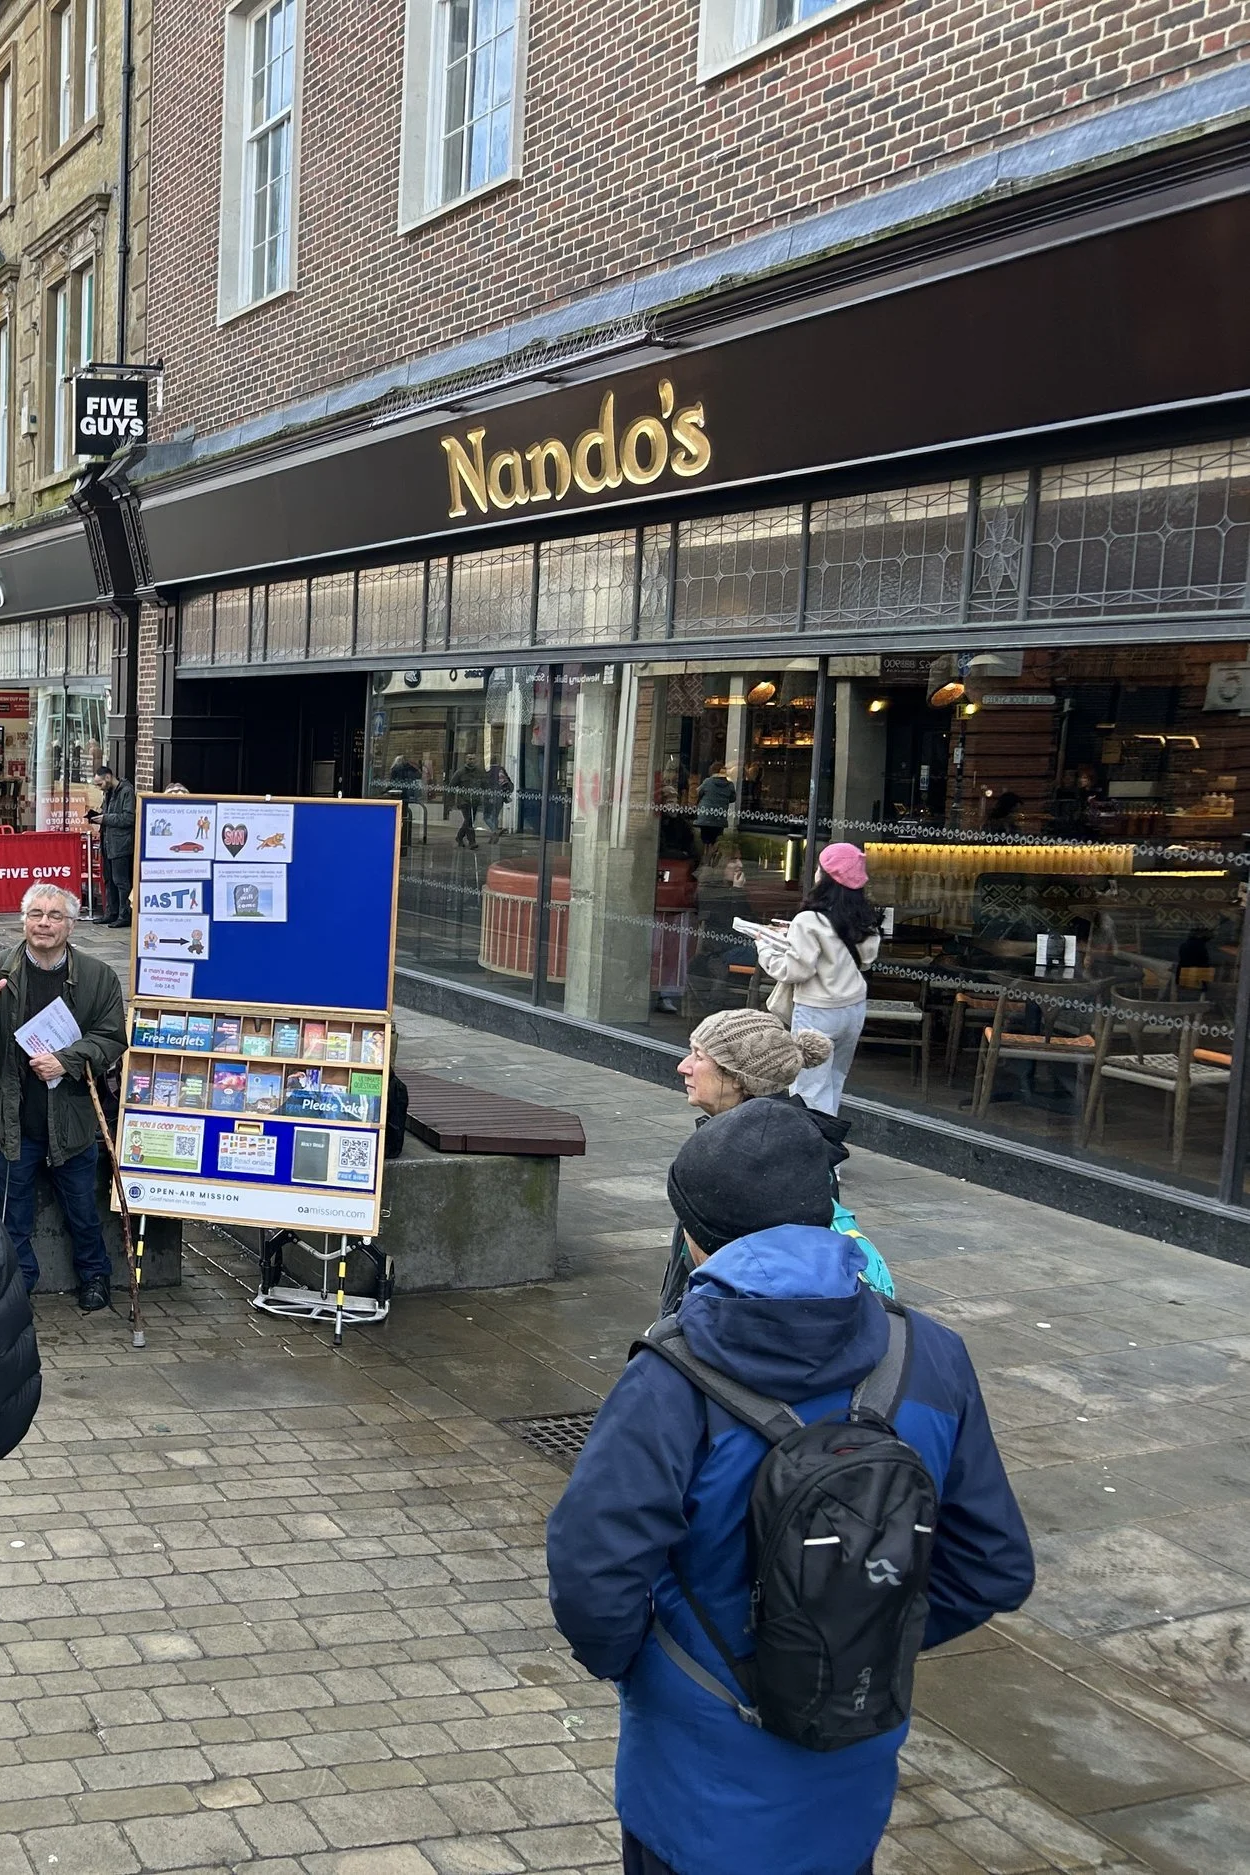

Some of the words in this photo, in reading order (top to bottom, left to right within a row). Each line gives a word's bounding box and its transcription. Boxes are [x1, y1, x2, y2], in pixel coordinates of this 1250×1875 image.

[86, 397, 138, 417] FIVE
[79, 417, 145, 437] GUYS
[440, 378, 711, 519] Nando's
[224, 829, 245, 846] SIN
[32, 866, 71, 878] GUYS
[144, 888, 190, 909] PAST
[141, 1032, 166, 1044] Free
[166, 1034, 206, 1047] leaflets
[301, 1098, 338, 1112] Please
[157, 1122, 174, 1130] GOOD
[149, 1187, 196, 1198] OPEN-AIR
[199, 1192, 240, 1202] MISSION
[297, 1206, 366, 1219] oamission.com
